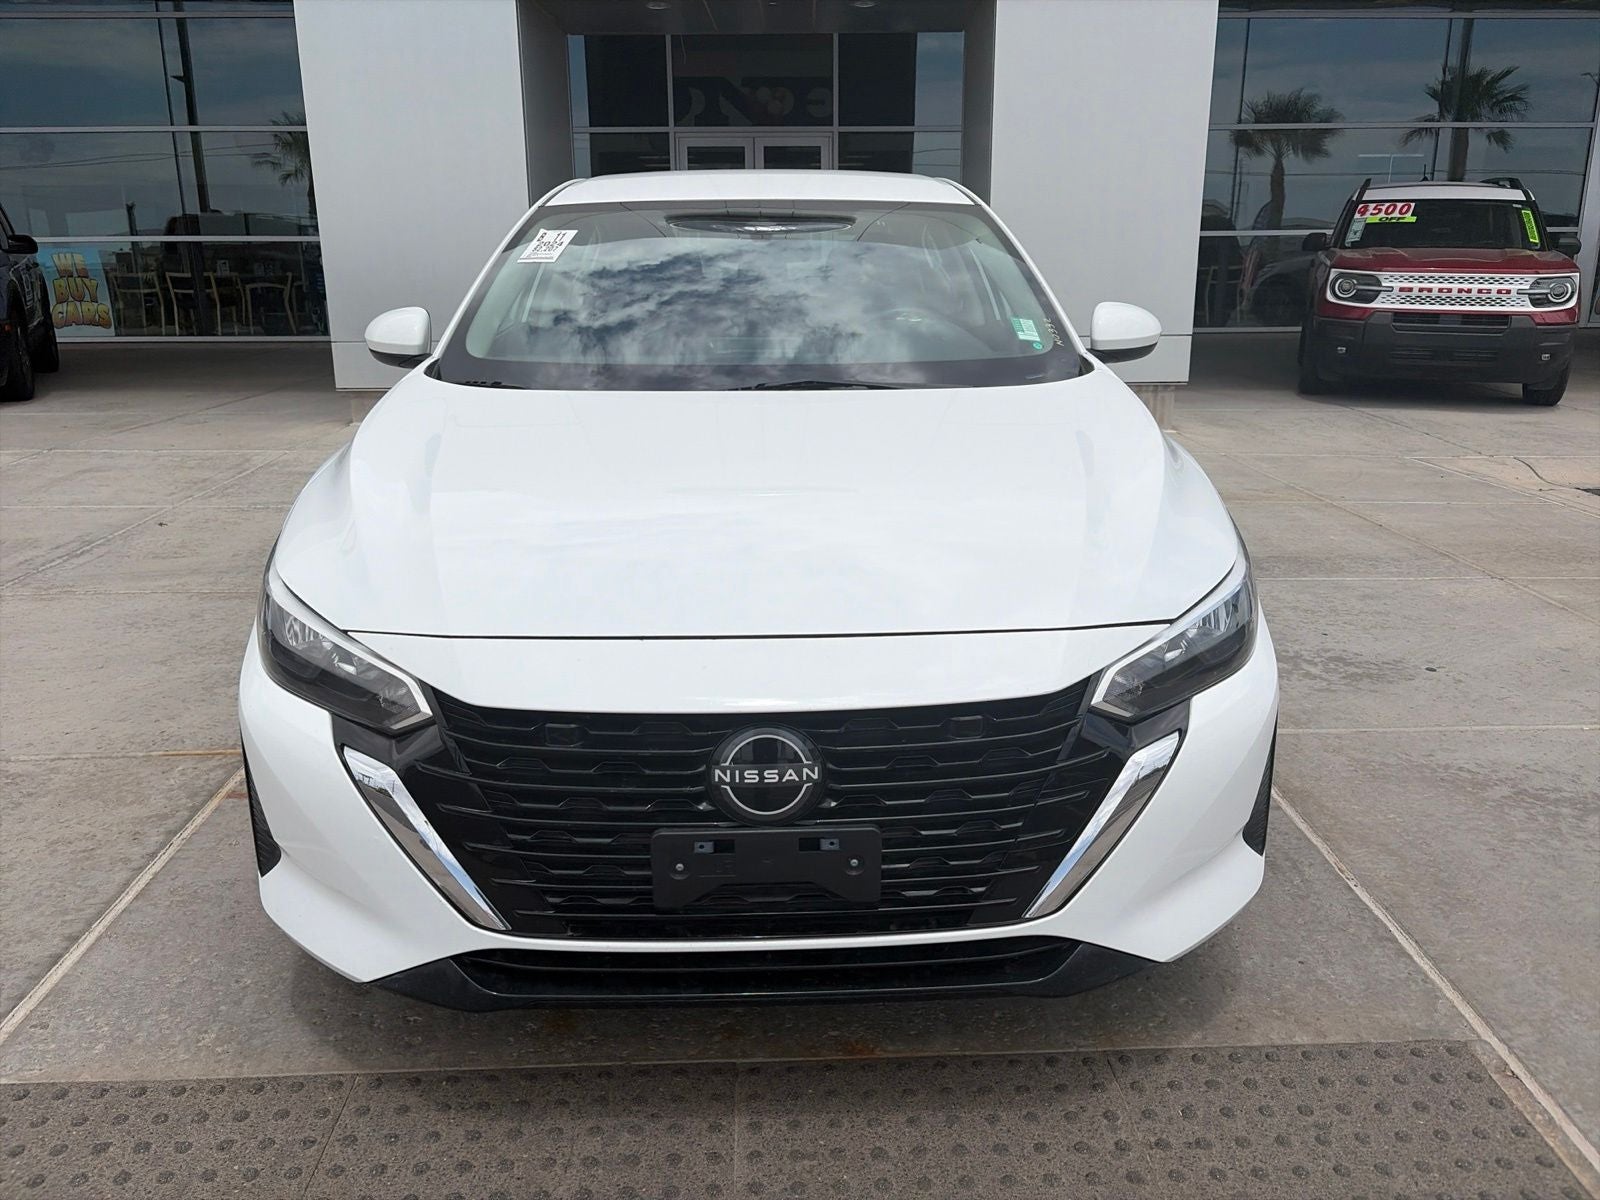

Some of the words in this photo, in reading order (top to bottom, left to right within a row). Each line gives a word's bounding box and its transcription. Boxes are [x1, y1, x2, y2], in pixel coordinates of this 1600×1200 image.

[51, 252, 90, 279] WE
[52, 277, 99, 304] BUY
[1398, 287, 1512, 295] BRONCO
[51, 301, 113, 330] CARS
[714, 766, 819, 783] NISSAN
